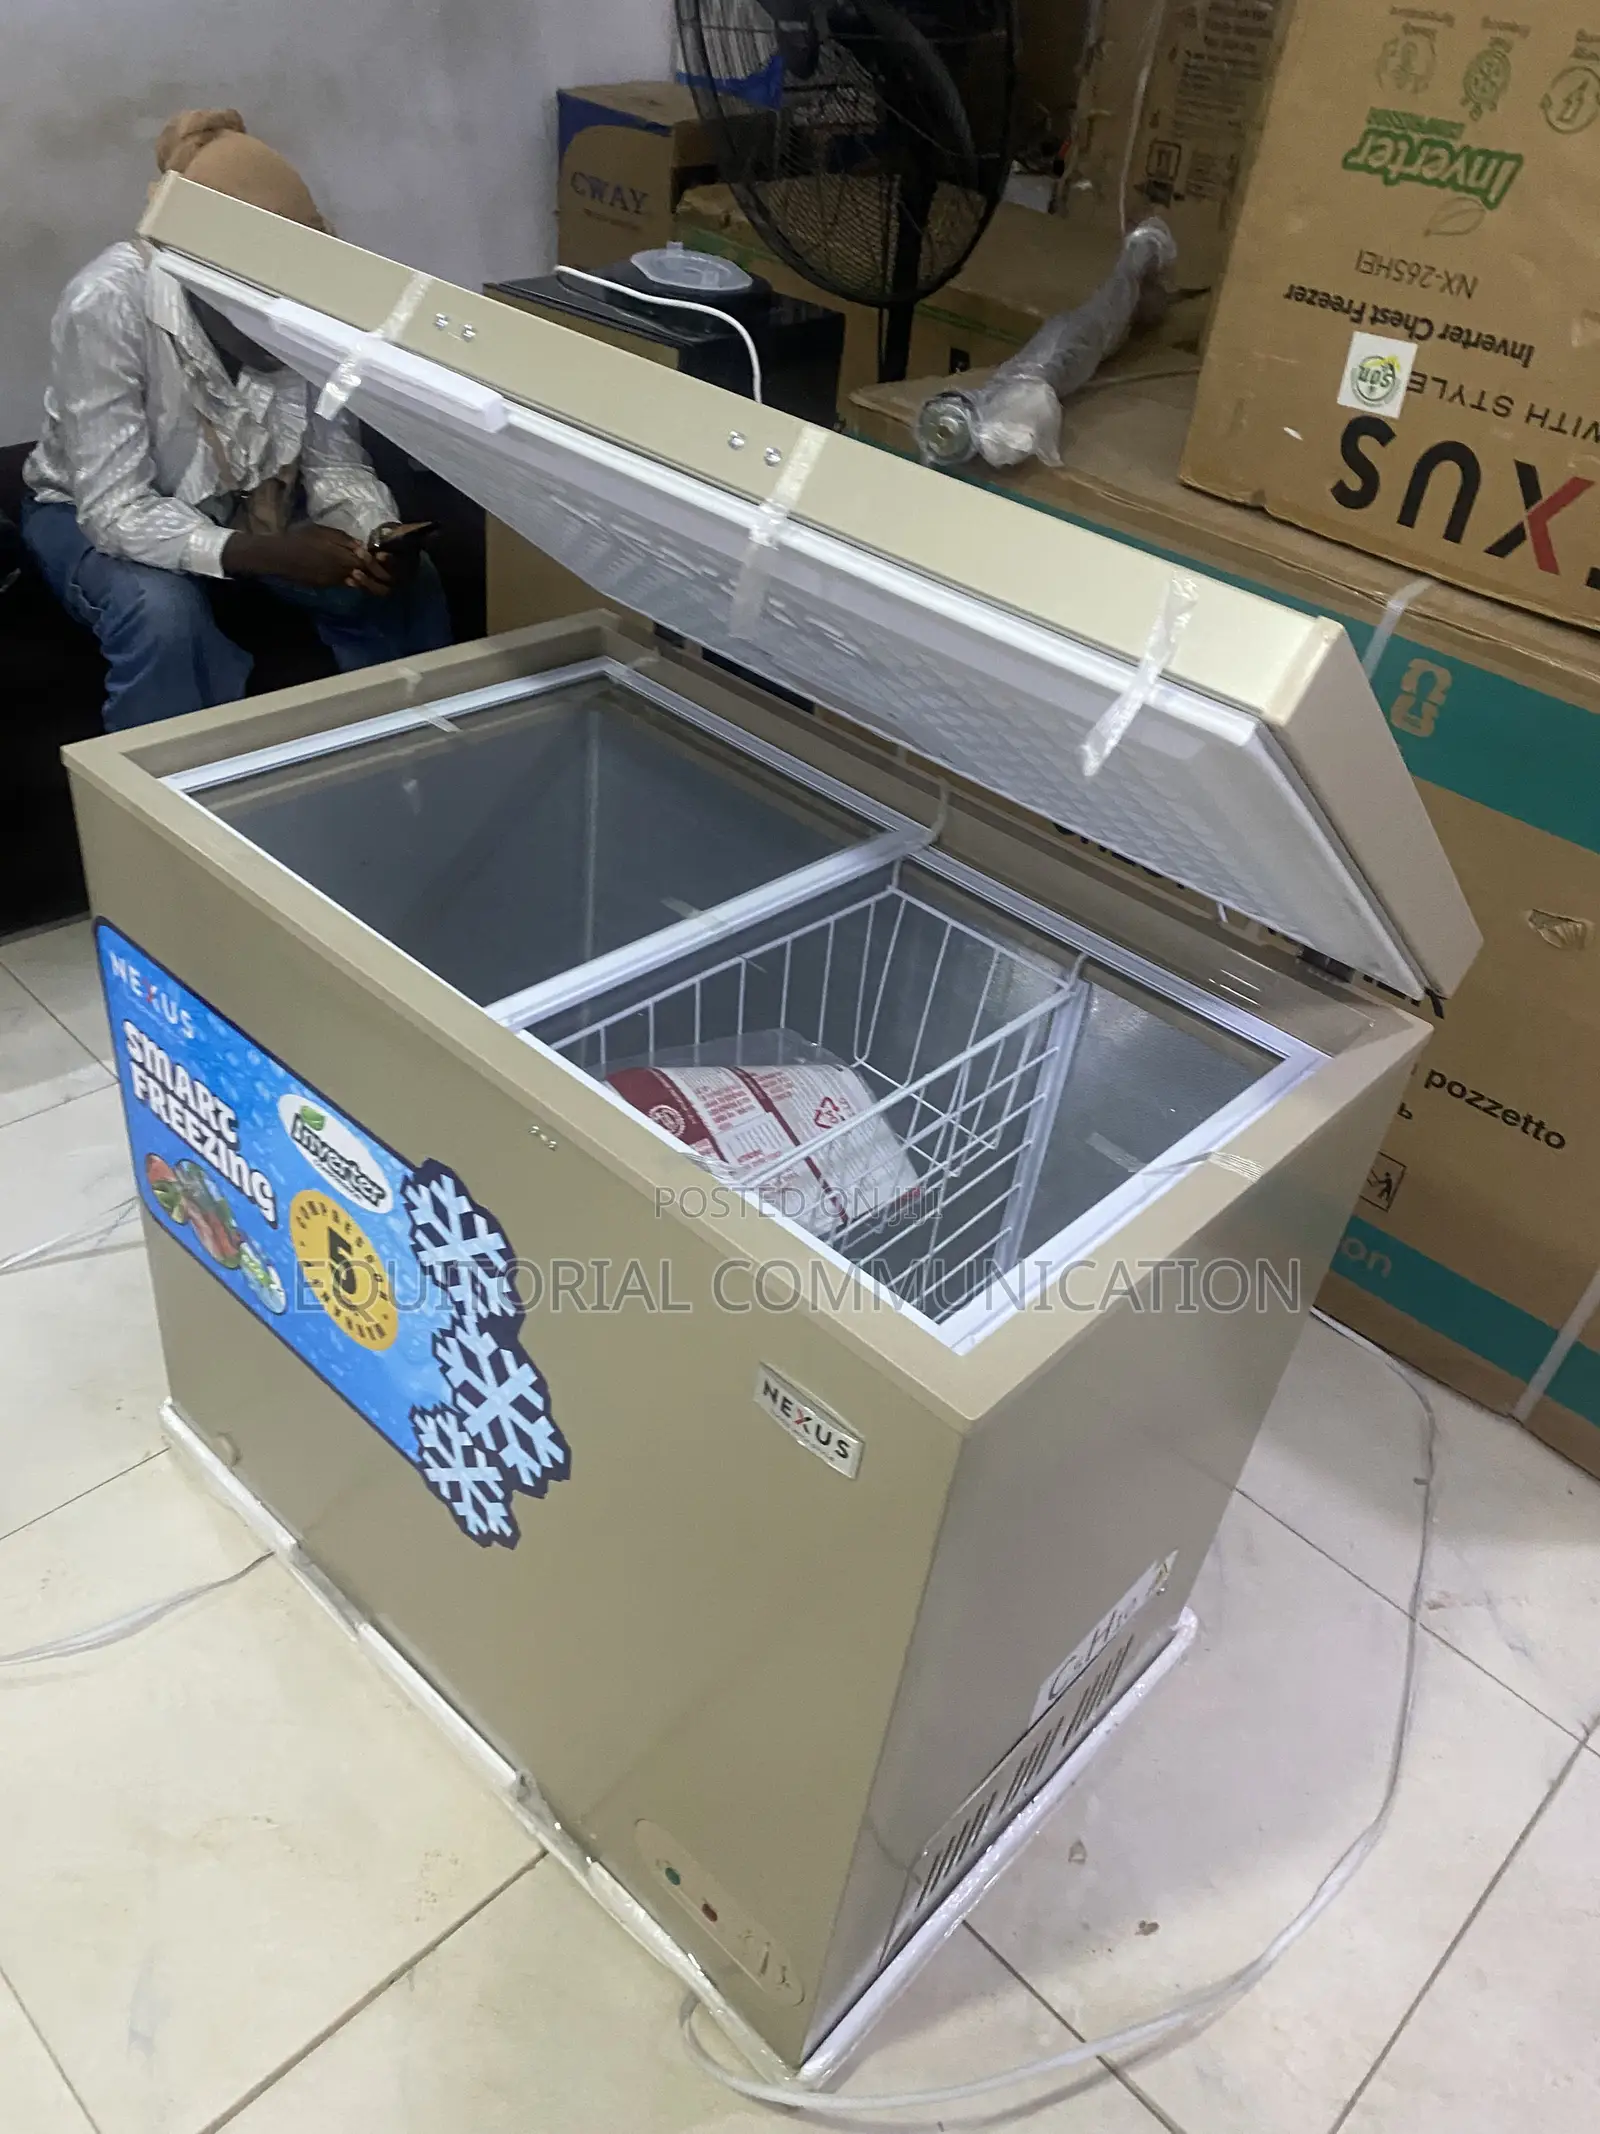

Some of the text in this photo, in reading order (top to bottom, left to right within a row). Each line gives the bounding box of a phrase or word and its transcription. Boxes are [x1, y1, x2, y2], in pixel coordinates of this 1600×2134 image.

[571, 171, 648, 216] CWAY
[1343, 129, 1523, 210] Inverter
[1283, 283, 1536, 369] Inverter Chest Freezer
[1406, 370, 1515, 418] STYLE
[1330, 414, 1600, 590] XUS
[107, 950, 196, 1040] NEXUS
[1424, 1068, 1566, 1151] pozzetto
[291, 1112, 386, 1207] Inverter
[327, 1225, 360, 1312] 5
[762, 1379, 851, 1460] NEXUS
